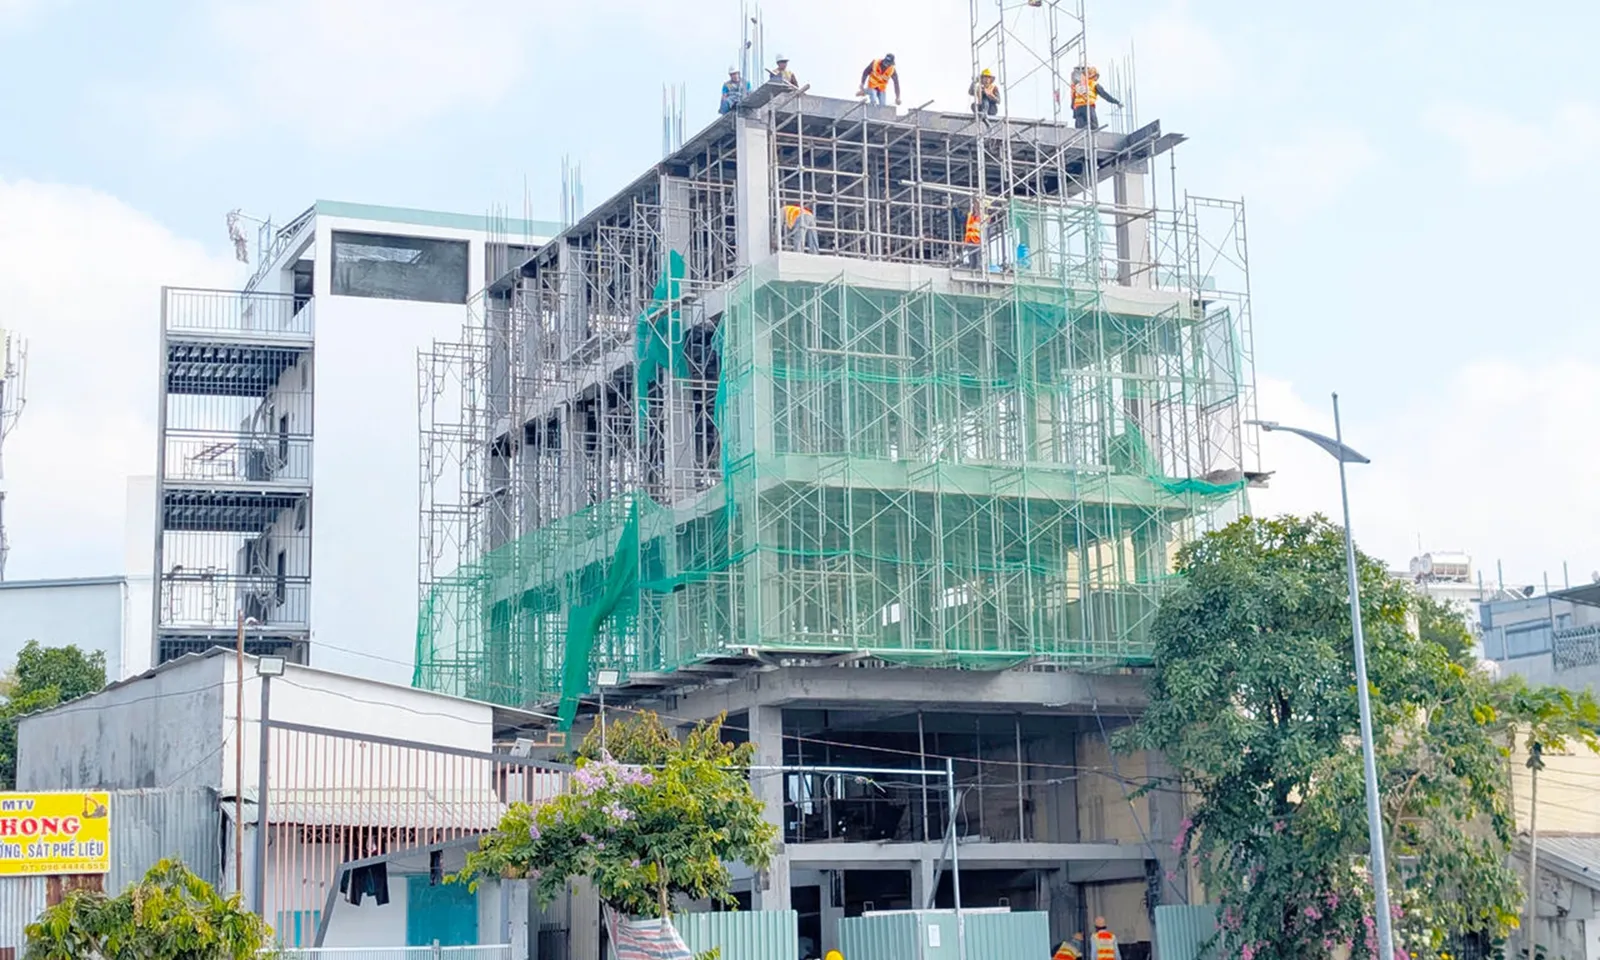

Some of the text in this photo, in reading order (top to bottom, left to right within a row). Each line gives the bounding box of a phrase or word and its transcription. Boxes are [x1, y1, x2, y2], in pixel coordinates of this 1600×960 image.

[2, 800, 34, 810] MTV
[0, 818, 80, 835] HONG
[28, 838, 50, 858] SẮT
[53, 838, 75, 857] PHẾ
[78, 839, 104, 860] LIỆU
